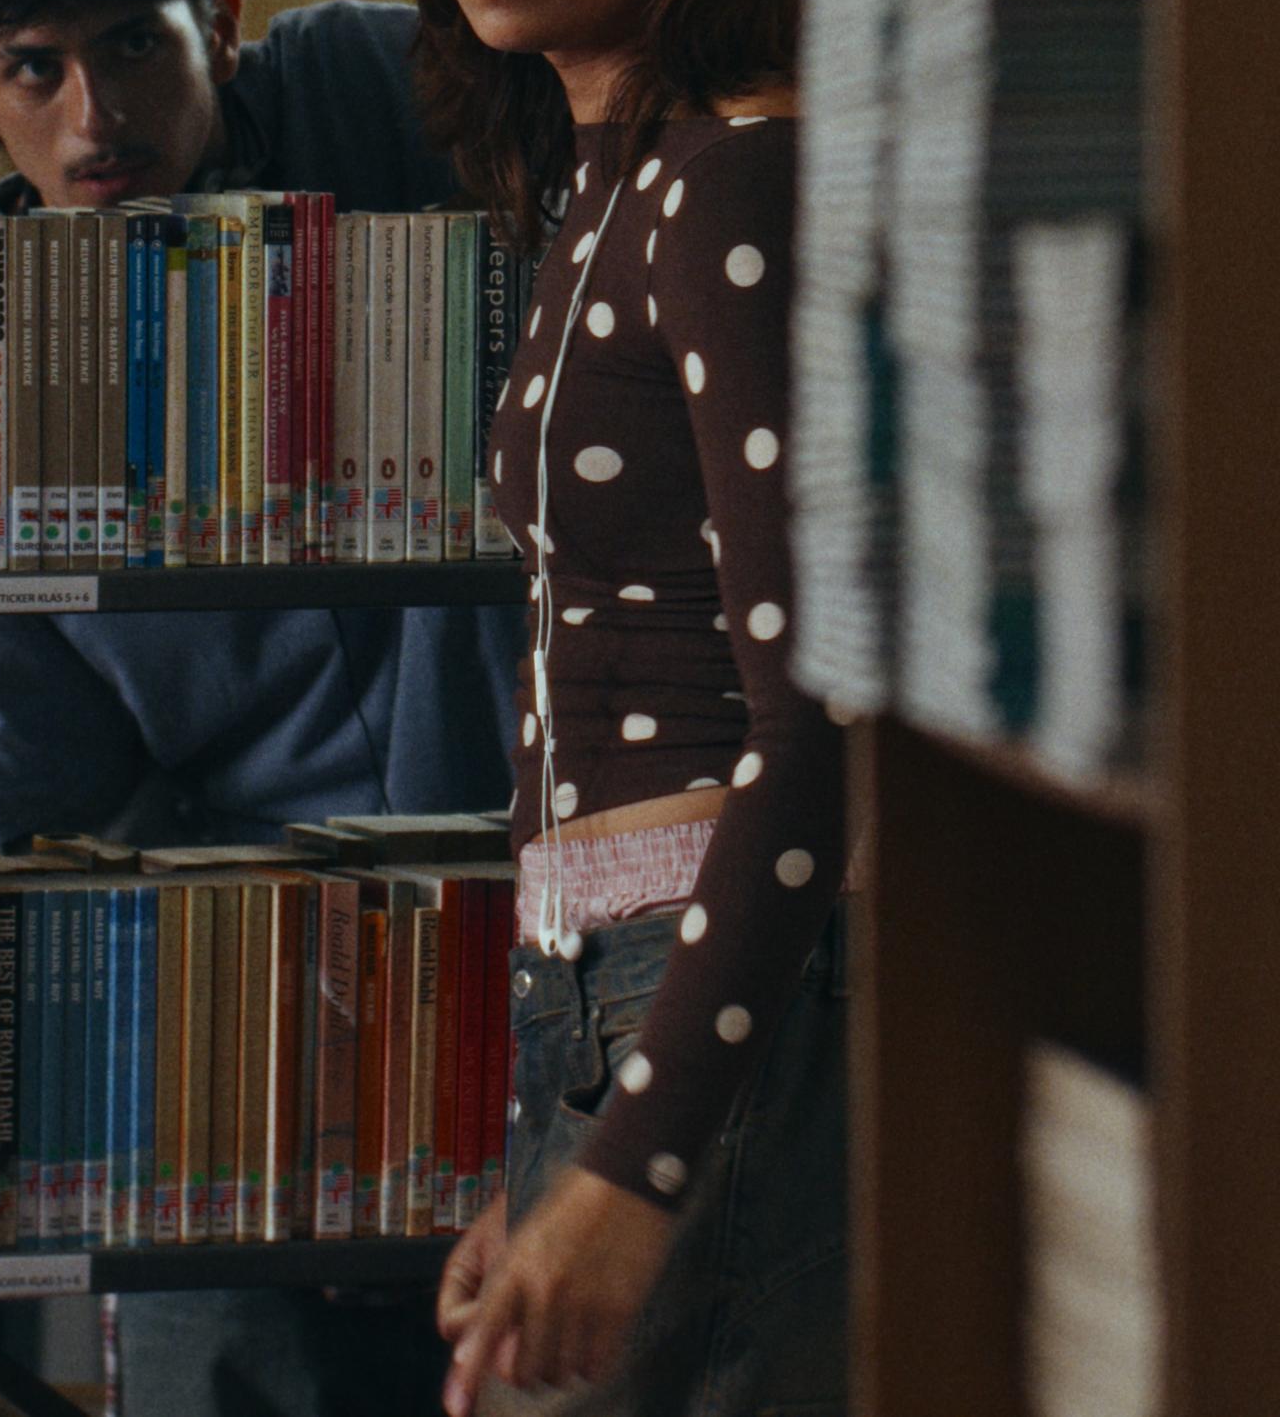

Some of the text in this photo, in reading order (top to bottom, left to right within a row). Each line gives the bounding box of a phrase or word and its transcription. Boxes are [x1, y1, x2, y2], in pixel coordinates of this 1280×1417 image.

[249, 206, 260, 290] EMPEROR
[249, 348, 260, 380] AIR
[38, 593, 62, 603] KLAS
[65, 593, 71, 603] 5
[83, 592, 89, 602] 6
[0, 907, 16, 942] THE
[330, 909, 351, 971] Roald
